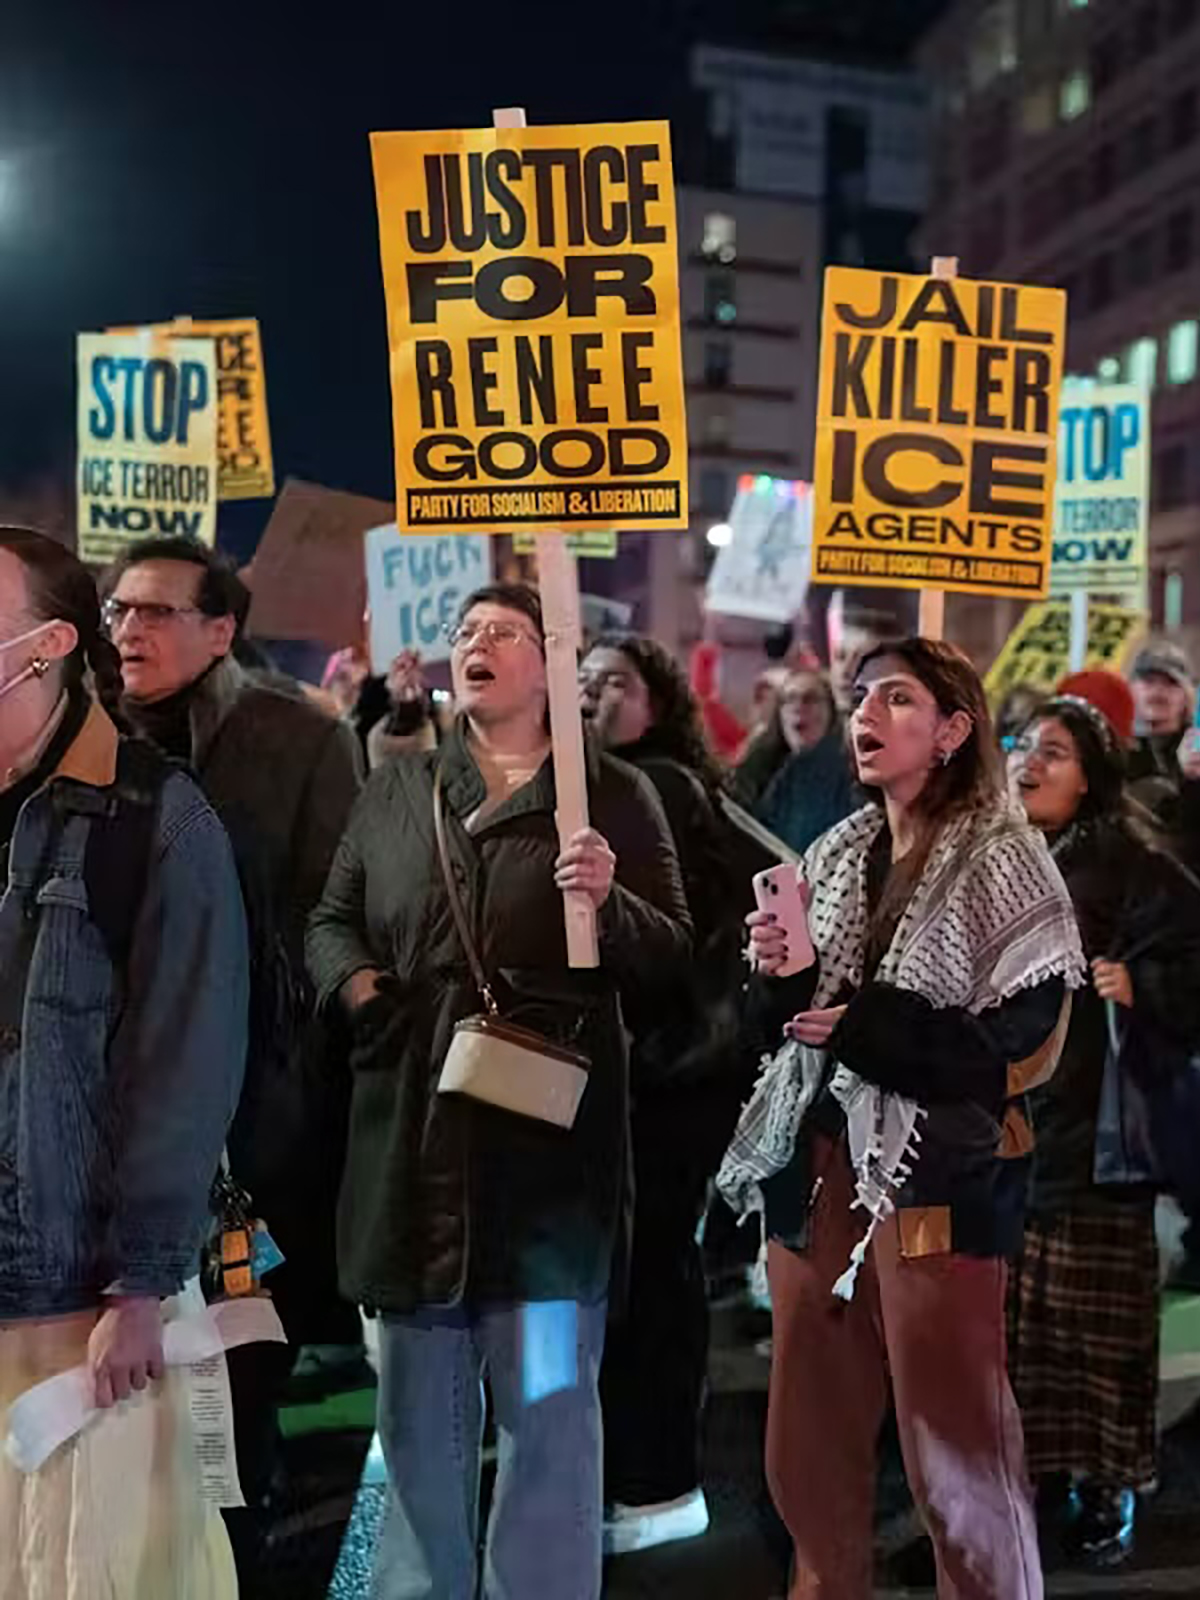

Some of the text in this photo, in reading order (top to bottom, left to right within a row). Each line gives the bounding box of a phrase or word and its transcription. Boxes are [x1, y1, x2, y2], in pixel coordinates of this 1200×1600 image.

[405, 144, 666, 253] JUSTICE
[405, 253, 657, 324] FOR
[834, 275, 1054, 343] JAIL
[88, 356, 209, 445] STOP
[415, 332, 659, 428] RENEE
[831, 332, 1049, 434] KILLER
[413, 428, 671, 480] GOOD
[831, 430, 1048, 519] ICE
[1060, 404, 1139, 483] TOP
[82, 458, 114, 497] ICE
[119, 461, 210, 506] TERROR
[411, 488, 677, 518] PARTY FOR SOCIALISM & LIBERATION
[89, 502, 203, 537] NOW
[826, 512, 1042, 552] AGENTS
[383, 534, 481, 589] FUCK
